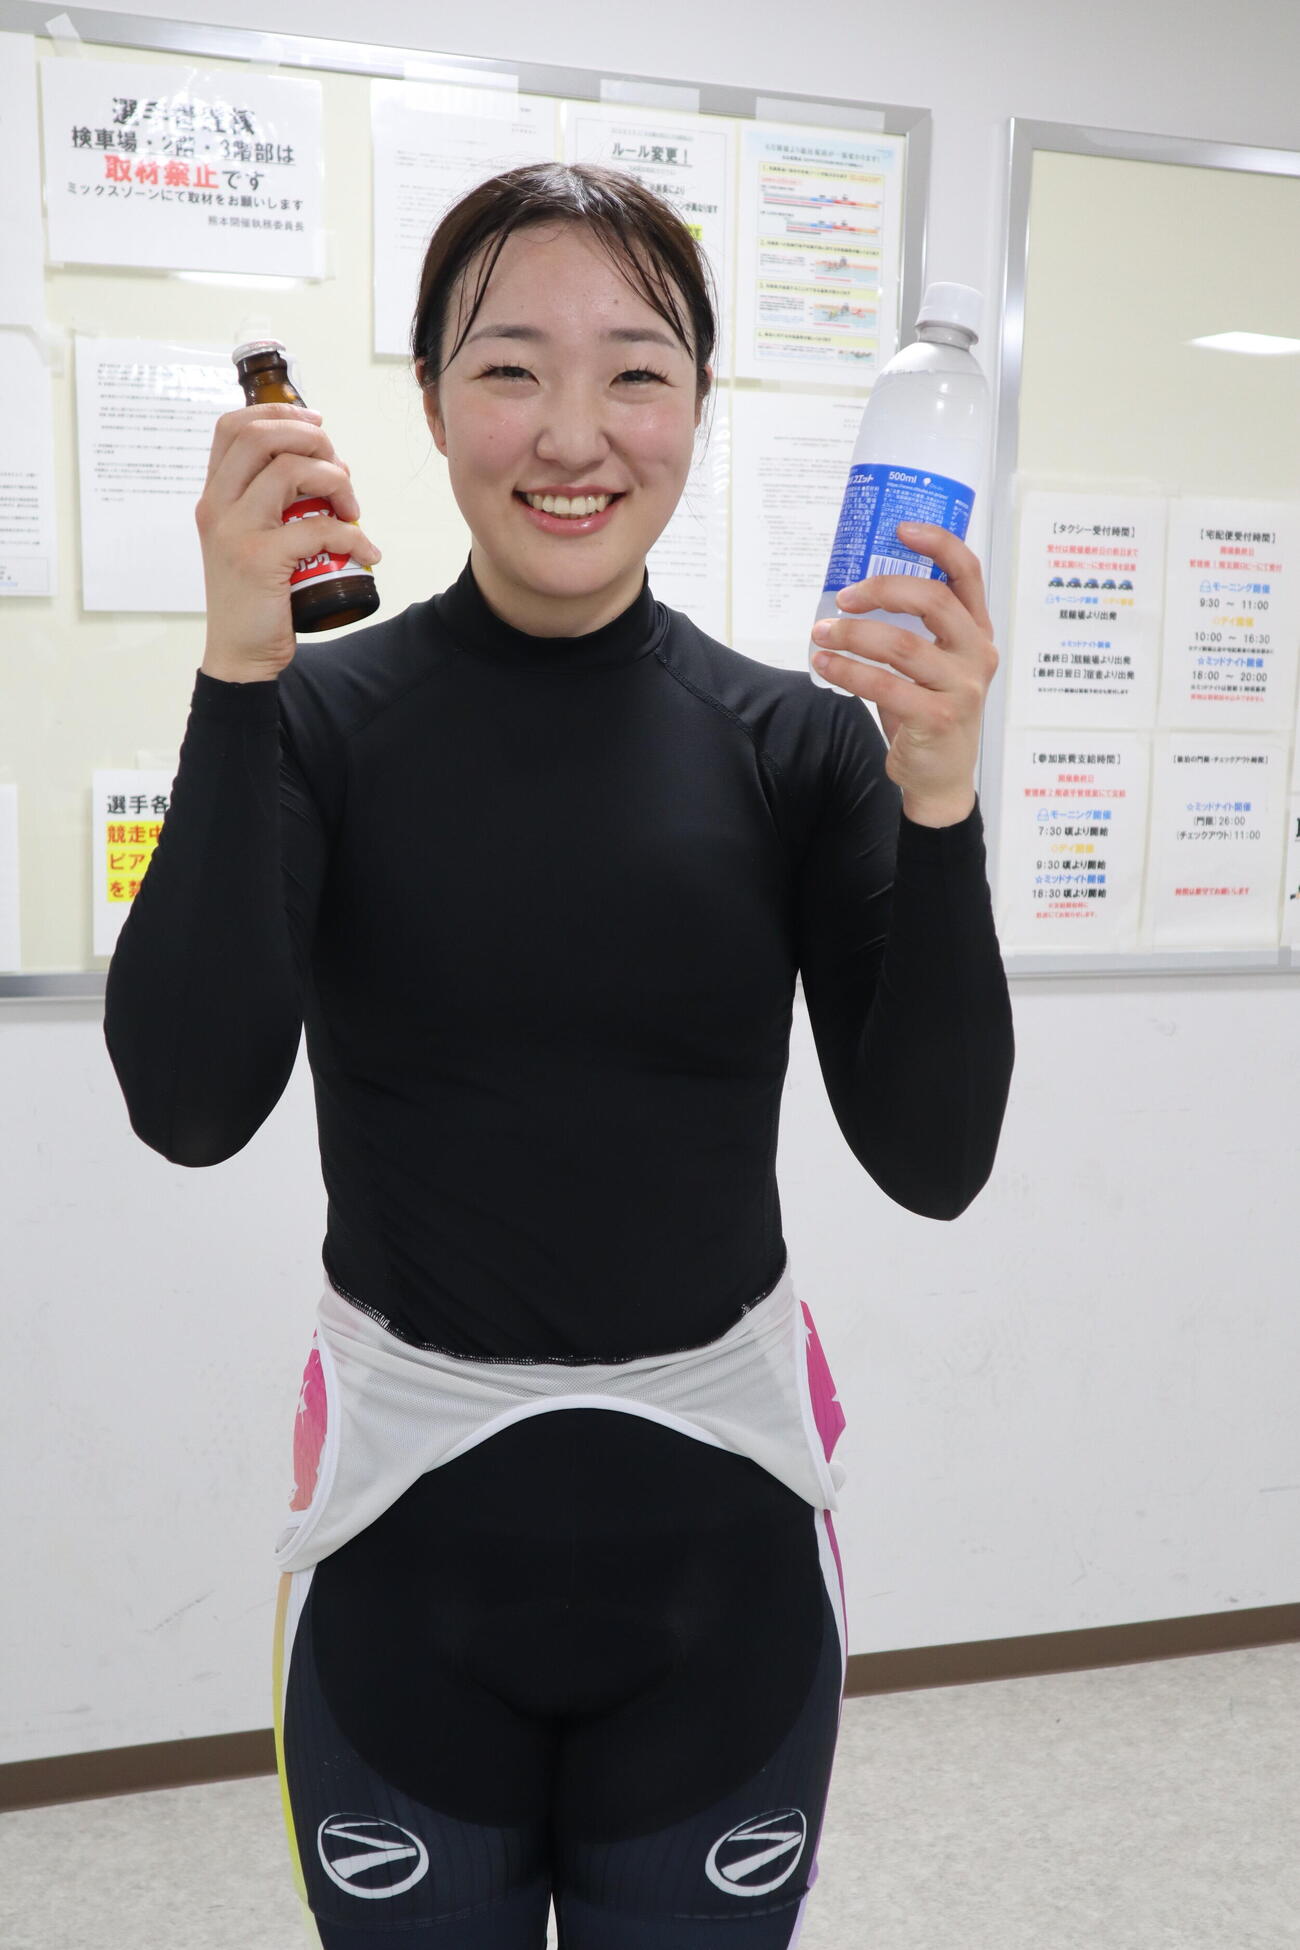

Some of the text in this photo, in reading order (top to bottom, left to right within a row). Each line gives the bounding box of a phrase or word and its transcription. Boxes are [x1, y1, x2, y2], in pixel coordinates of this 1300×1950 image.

[104, 154, 265, 191] 取材禁止です
[889, 471, 917, 483] 500ml
[1200, 598, 1220, 608] 9:30
[1242, 600, 1269, 610] 11:00
[1195, 632, 1222, 643] 10:00
[1240, 672, 1268, 683] 20:00
[106, 794, 170, 815] 選手各
[1038, 826, 1062, 836] 7:30
[1036, 860, 1060, 870] 9:30
